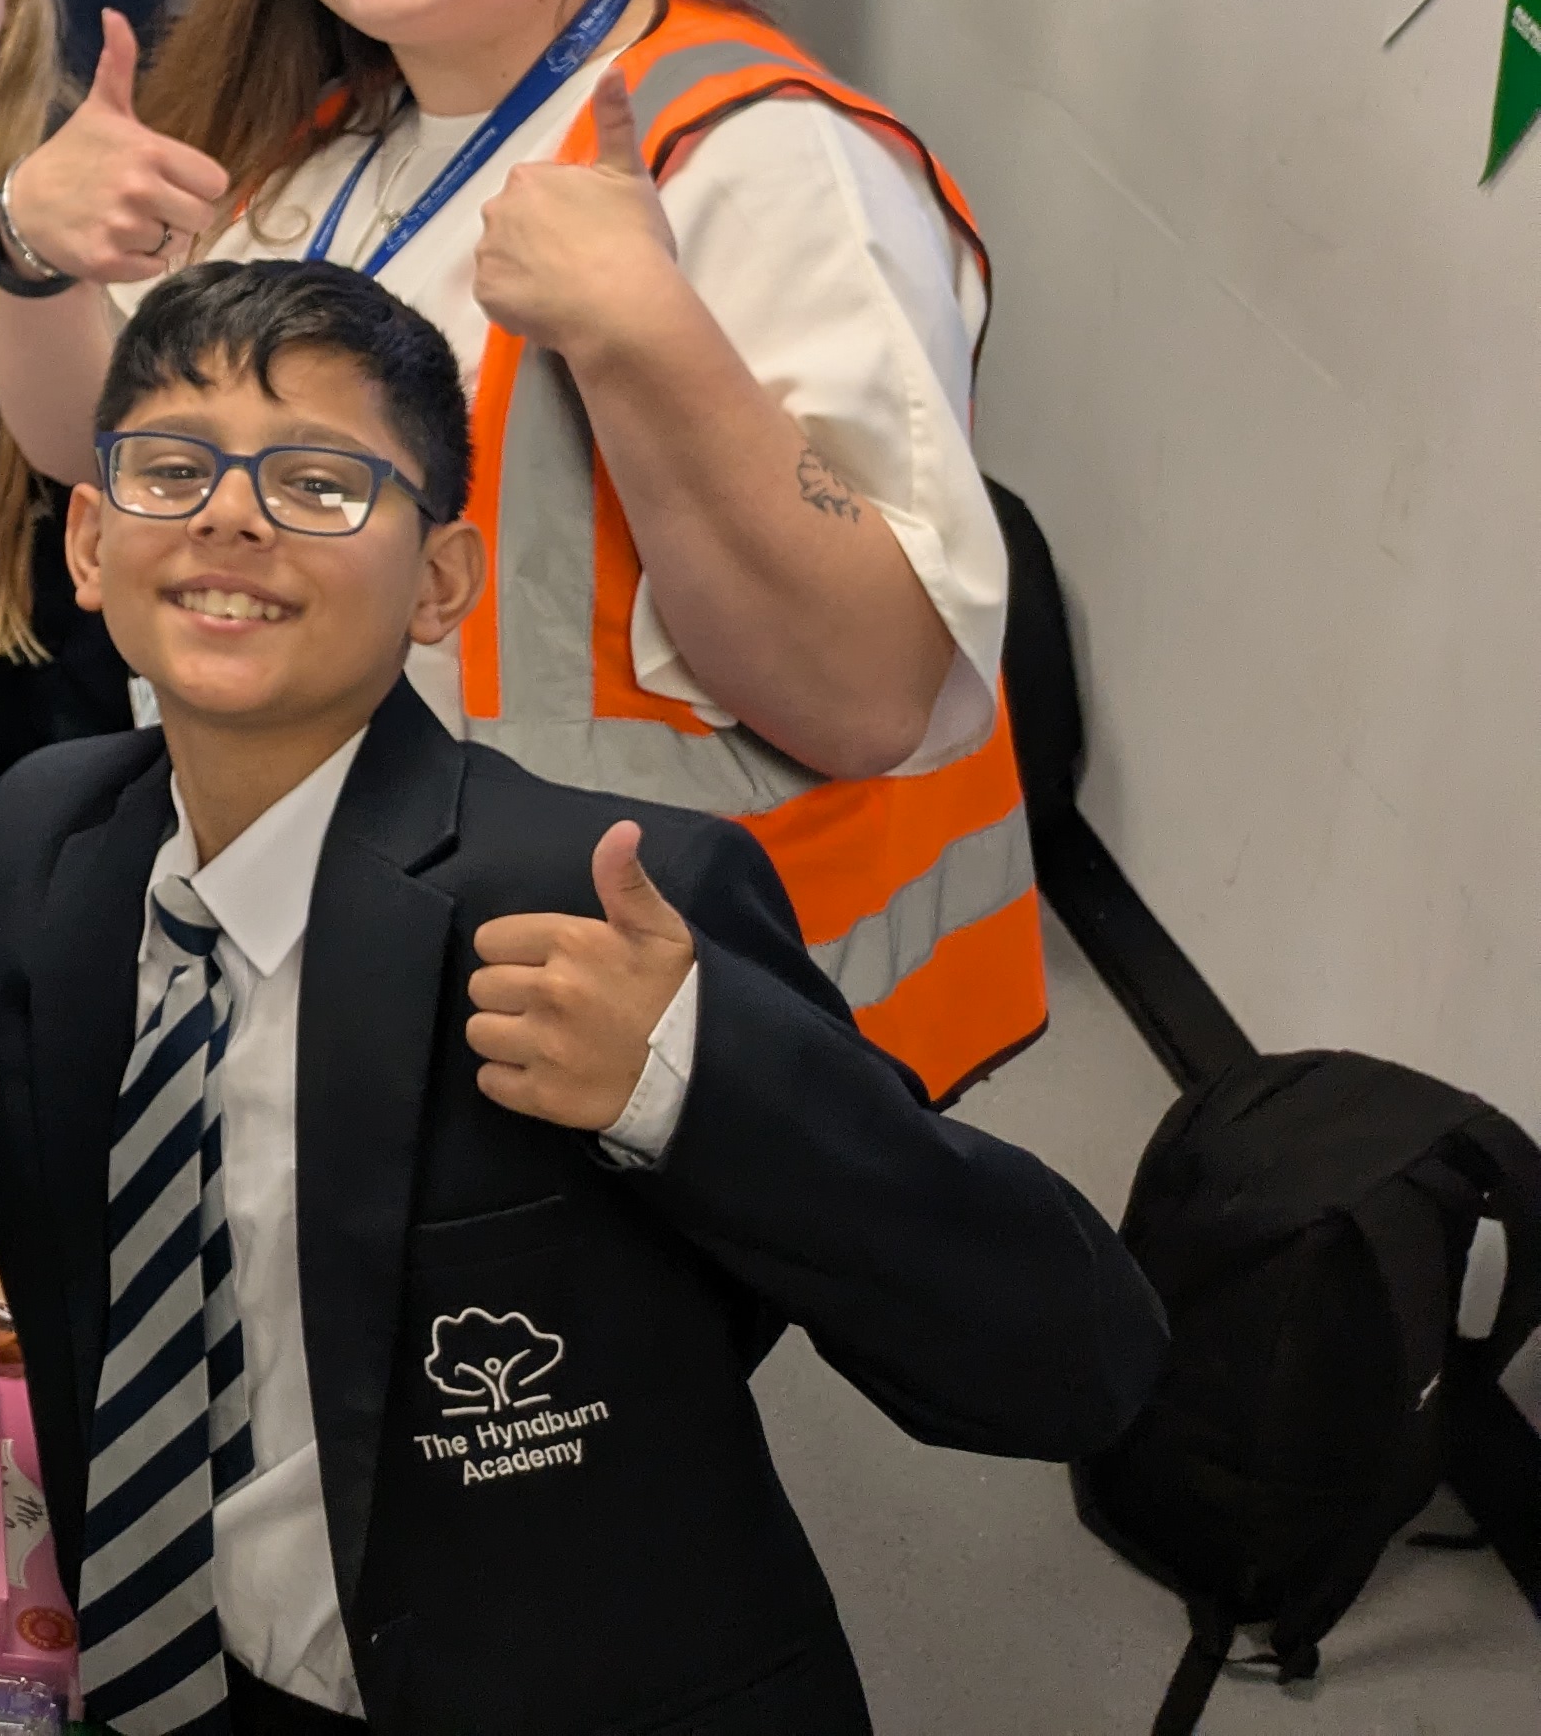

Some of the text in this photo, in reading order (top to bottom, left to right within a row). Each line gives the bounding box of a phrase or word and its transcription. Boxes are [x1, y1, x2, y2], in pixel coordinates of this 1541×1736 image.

[413, 1399, 610, 1461] The Hyndburn
[463, 1437, 584, 1486] Academy
